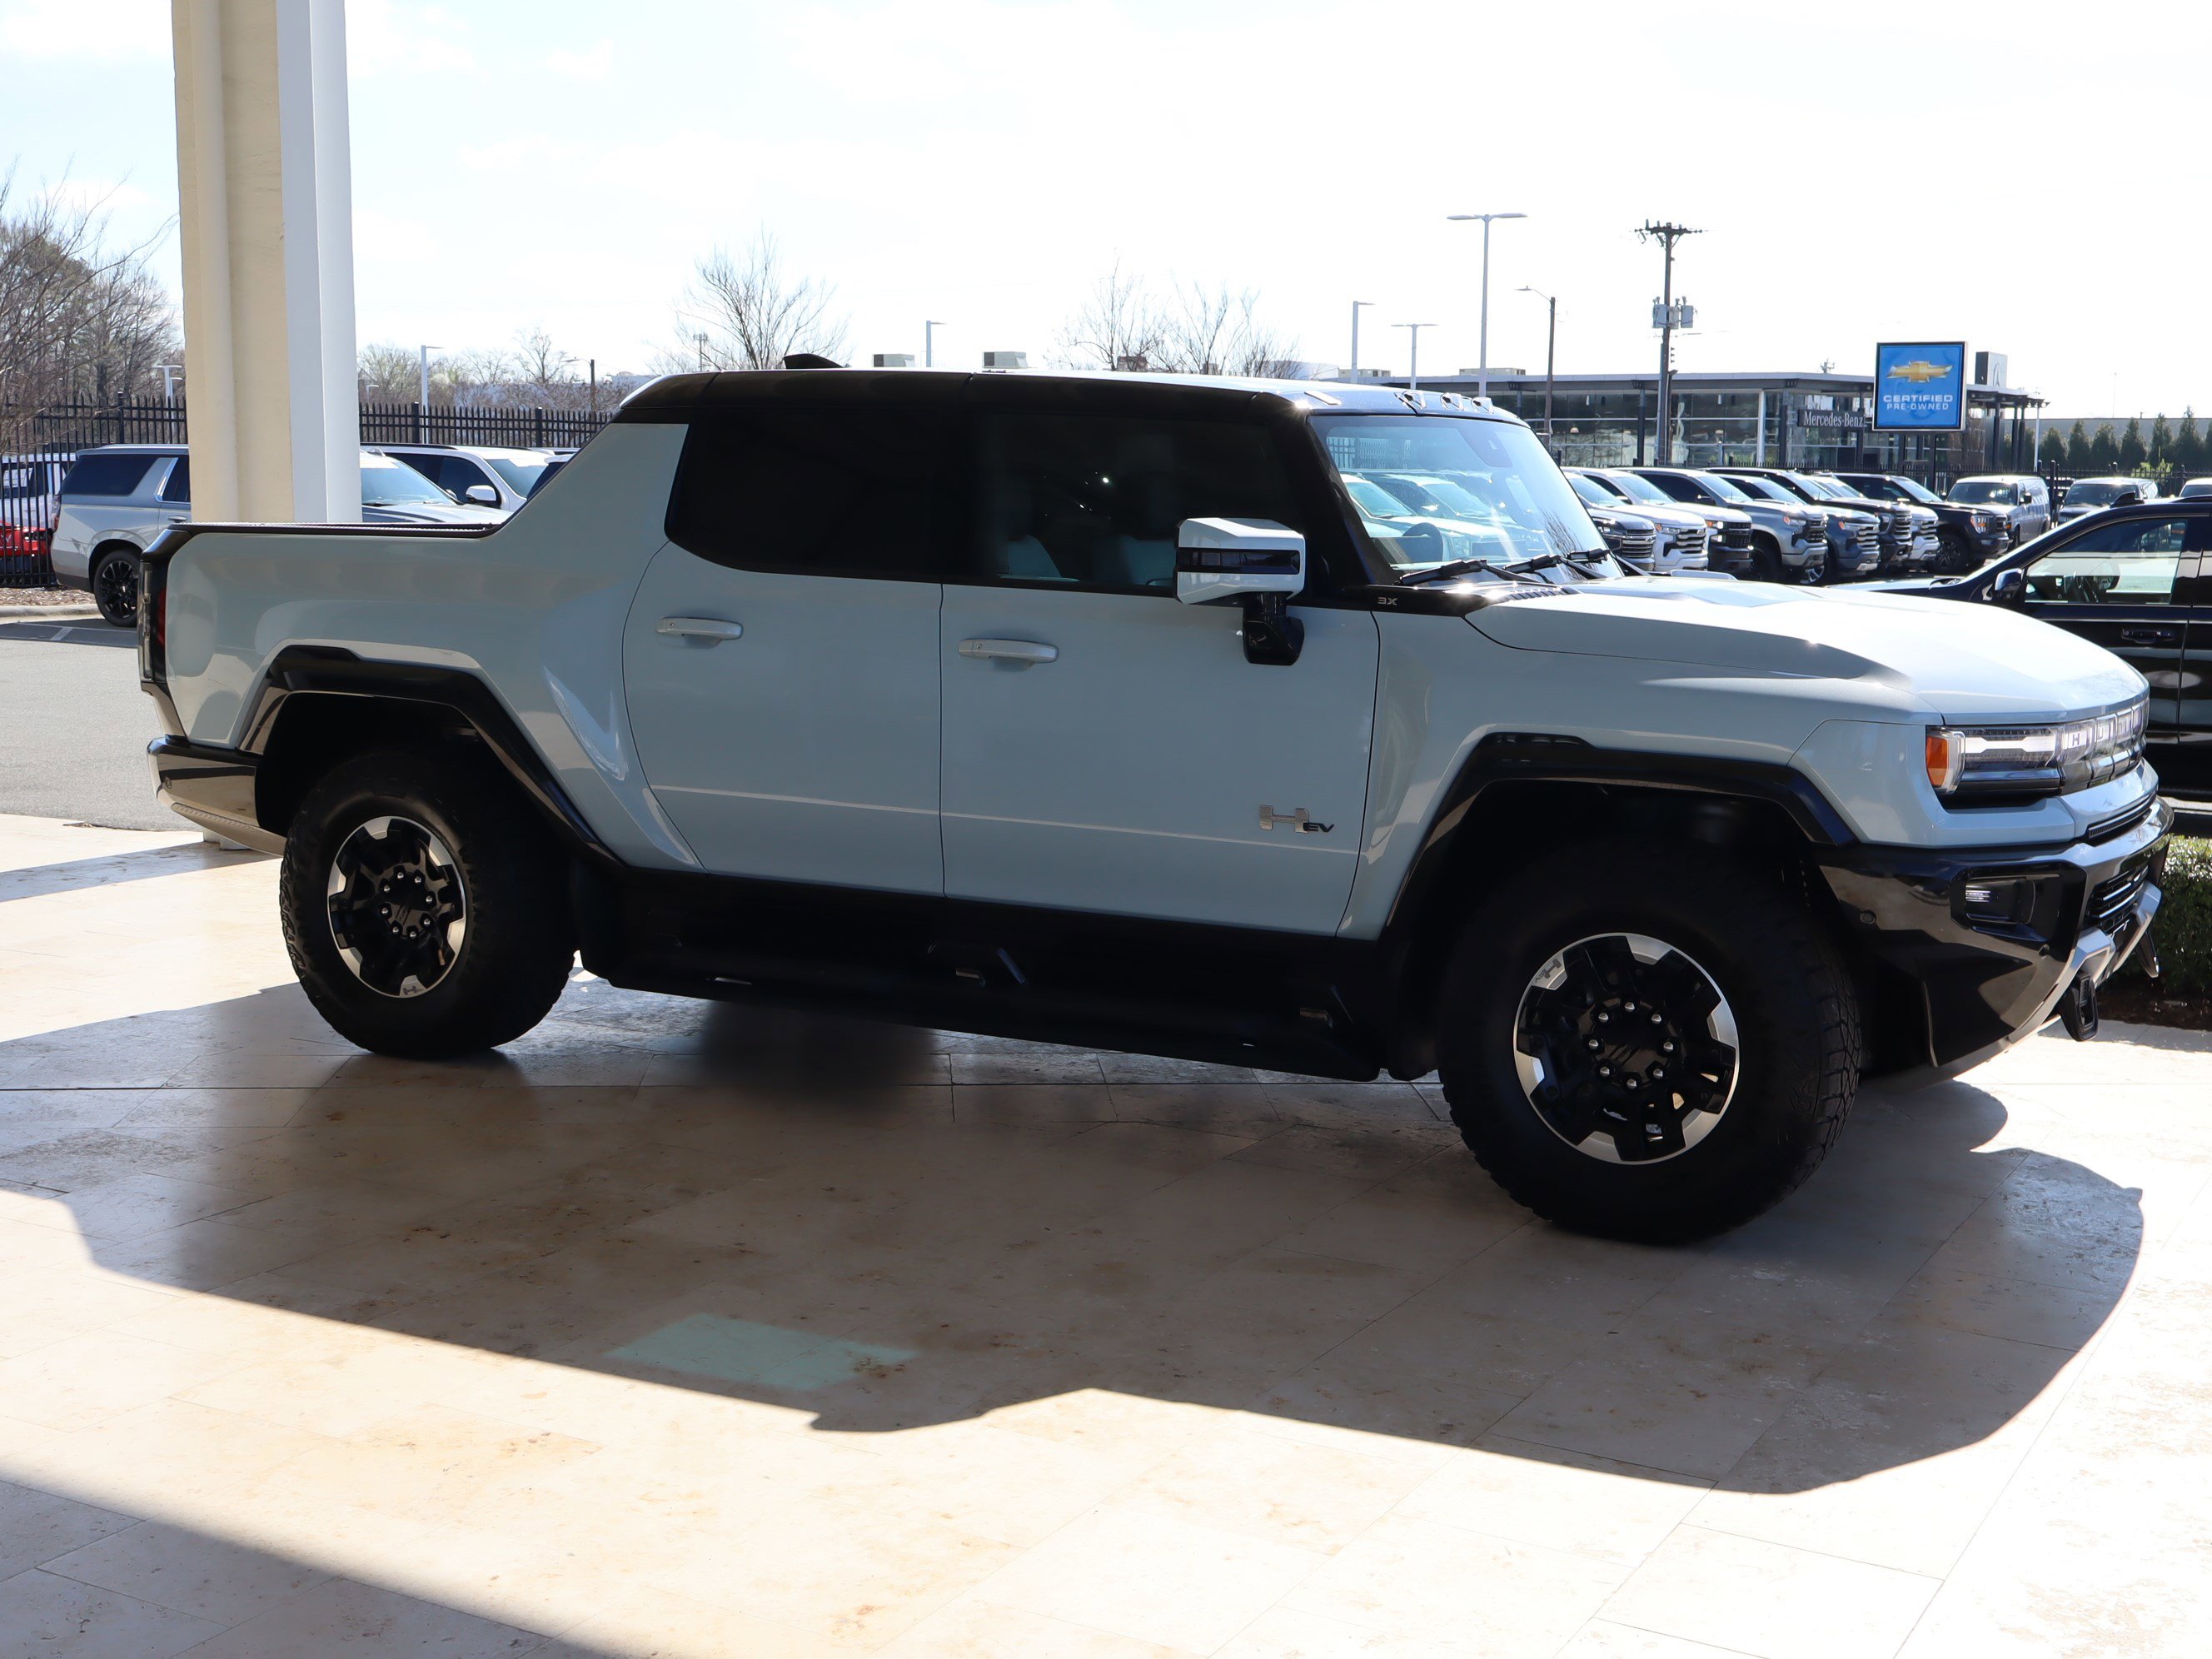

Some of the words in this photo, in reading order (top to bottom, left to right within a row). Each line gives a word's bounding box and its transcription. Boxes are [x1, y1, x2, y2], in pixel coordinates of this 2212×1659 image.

[1883, 394, 1954, 403] CERTIFIED
[1886, 402, 1950, 411] PRE-OWNED
[1802, 411, 1864, 427] Mercedes-Benz
[1377, 596, 1398, 605] 3X
[1303, 822, 1334, 833] EV
